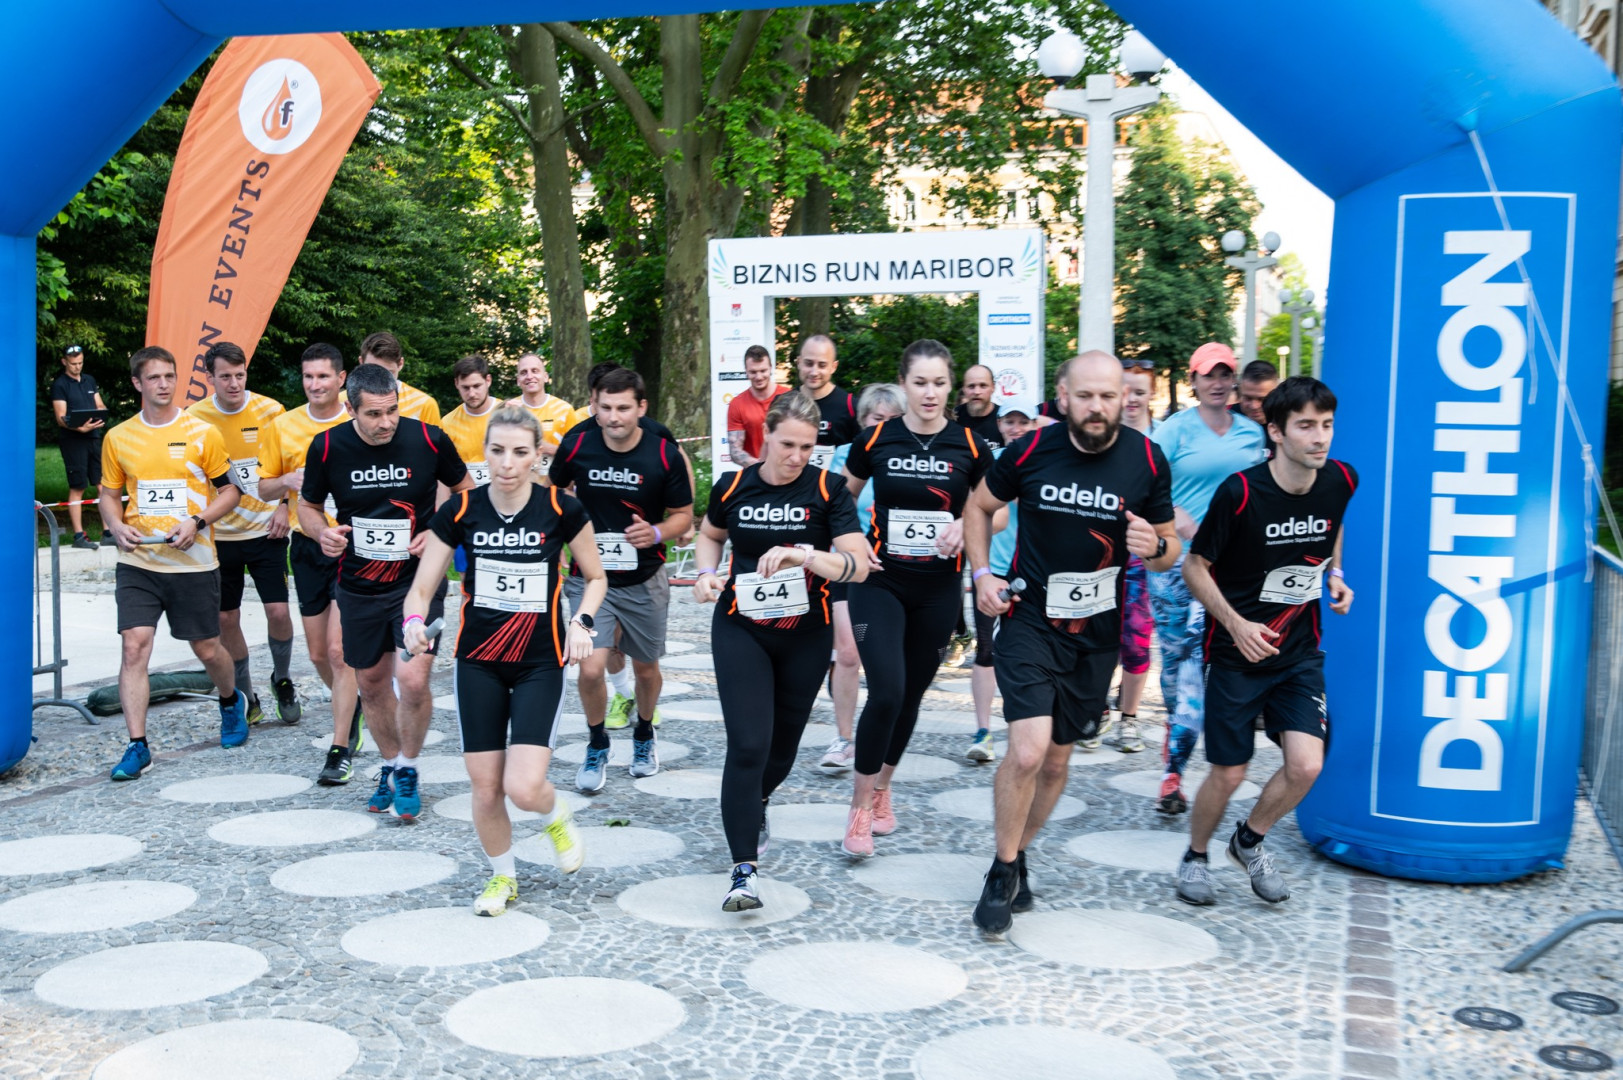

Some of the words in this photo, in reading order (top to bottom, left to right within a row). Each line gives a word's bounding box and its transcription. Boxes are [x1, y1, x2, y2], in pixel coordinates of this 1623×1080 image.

[733, 263, 816, 285] BIZNIS
[826, 261, 879, 282] RUN
[890, 257, 1014, 280] MARIBOR
[184, 320, 222, 411] URN
[208, 158, 270, 310] EVENTS
[147, 489, 175, 503] 2-4
[1417, 229, 1532, 792] DECATHLON
[366, 530, 395, 545] 5-2
[905, 523, 936, 539] 6-3
[496, 575, 525, 594] 5-1
[754, 582, 789, 602] 6-4
[1070, 583, 1099, 601] 6-1
